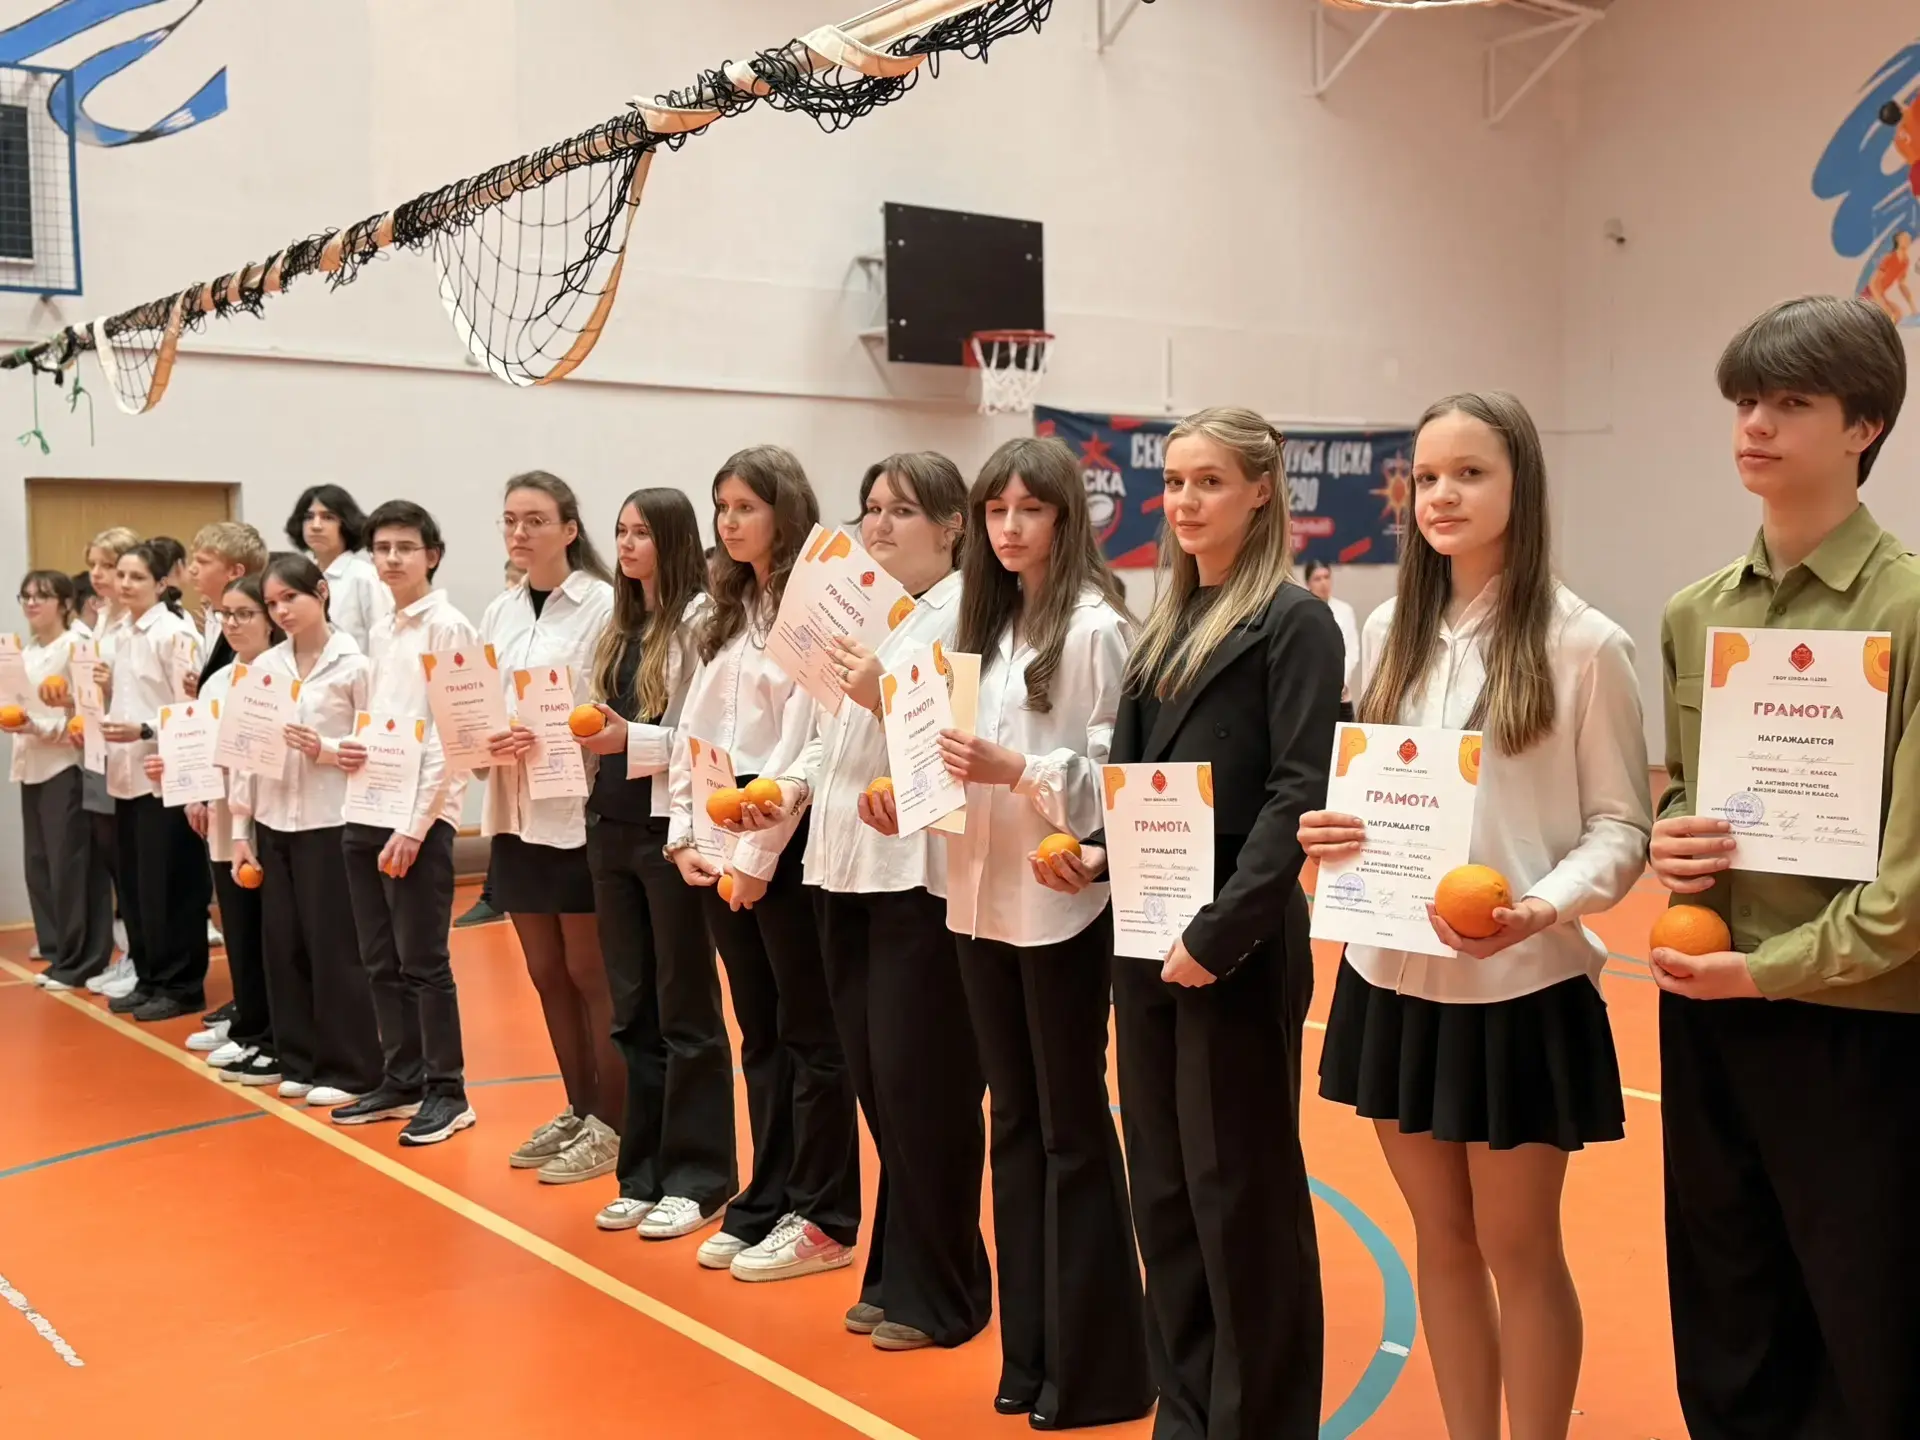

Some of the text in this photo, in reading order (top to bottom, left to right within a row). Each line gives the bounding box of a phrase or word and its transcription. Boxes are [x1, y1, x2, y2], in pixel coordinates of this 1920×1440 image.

[1327, 440, 1372, 479] ЦСКА
[1082, 468, 1126, 497] СКА
[1288, 477, 1319, 512] 290
[825, 583, 865, 627] ГРАМОТА
[904, 697, 935, 724] ГРАМОТА
[1753, 701, 1844, 720] ГРАМОТА
[1757, 734, 1834, 746] НАГРАЖДАЕТСЯ
[1765, 780, 1799, 788] АКТИВНОЕ
[1800, 782, 1830, 790] УЧАСТИЕ
[1366, 789, 1440, 809] ГРАМОТА
[1134, 820, 1191, 832] ГРАМОТА
[1367, 820, 1431, 832] НАГРАЖДАЕТСЯ
[1140, 847, 1187, 855] НАГРАЖДАЕТСЯ
